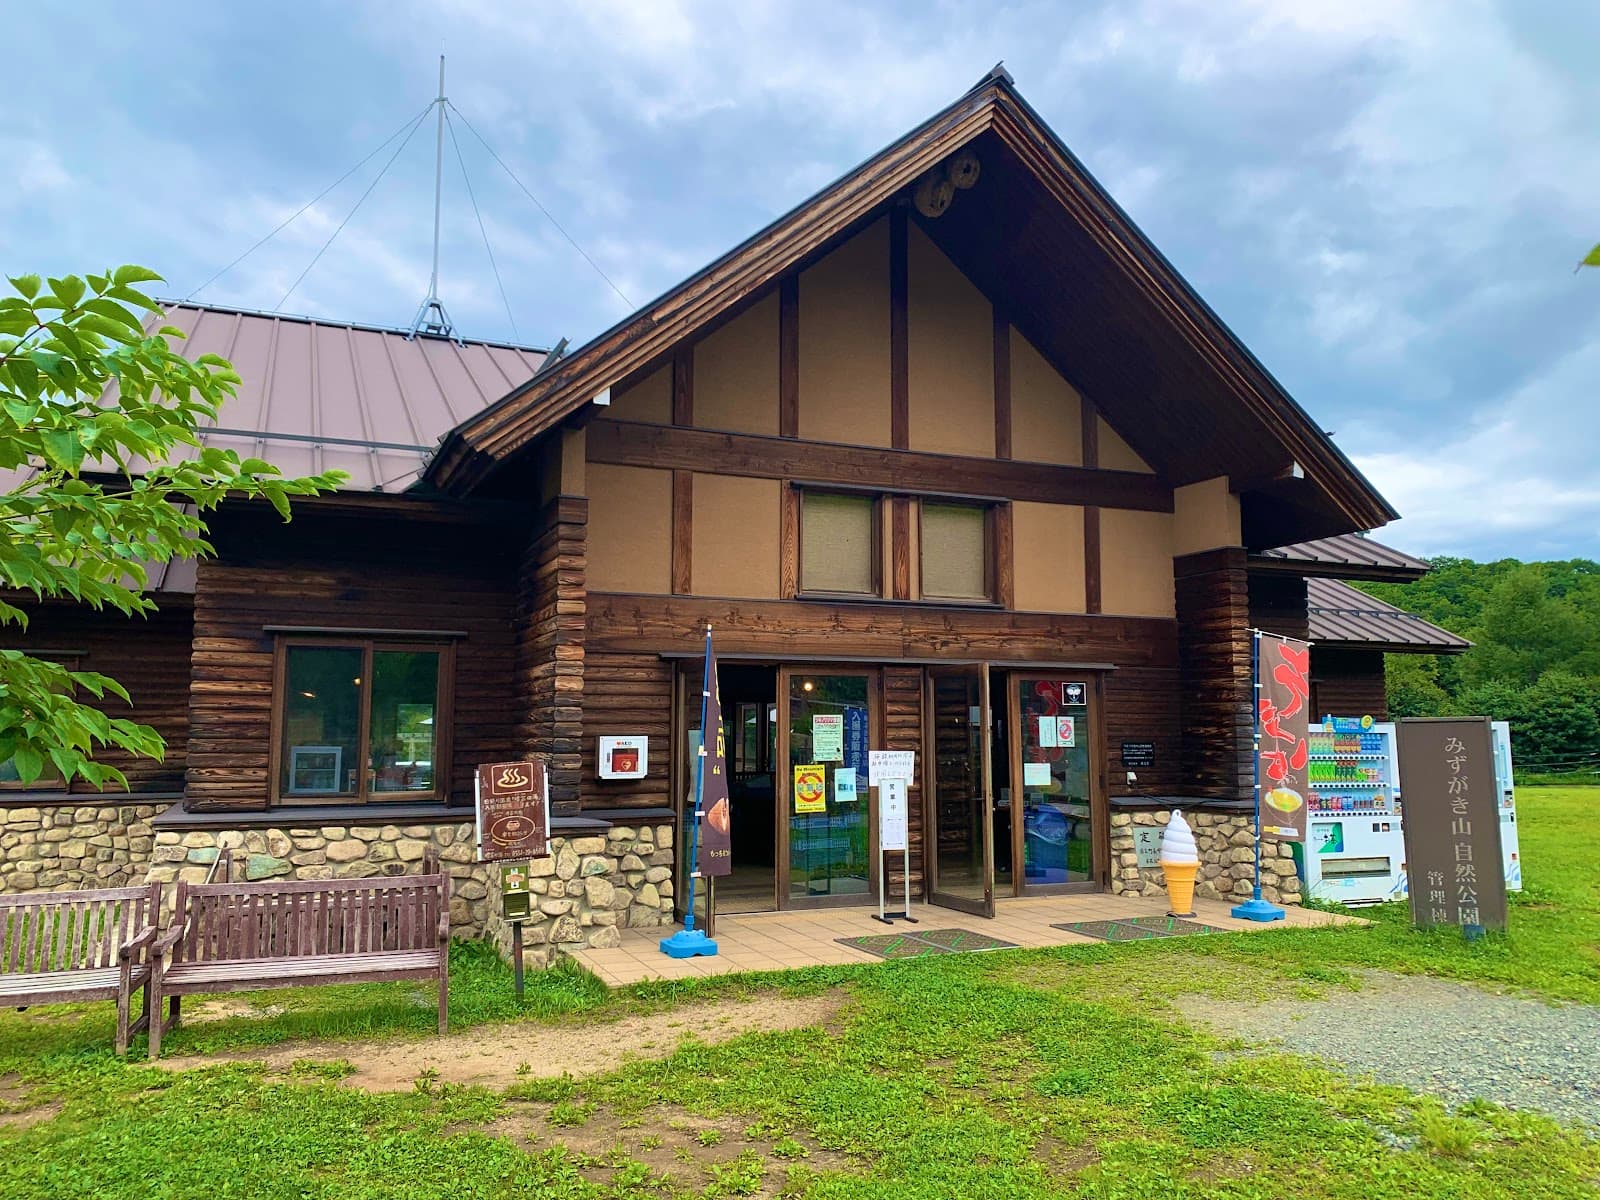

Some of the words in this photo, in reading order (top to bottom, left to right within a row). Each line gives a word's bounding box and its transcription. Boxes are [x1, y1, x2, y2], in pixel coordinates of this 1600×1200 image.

[1444, 736, 1480, 926] みずがき山自然公園
[1427, 870, 1447, 923] 管理棟
